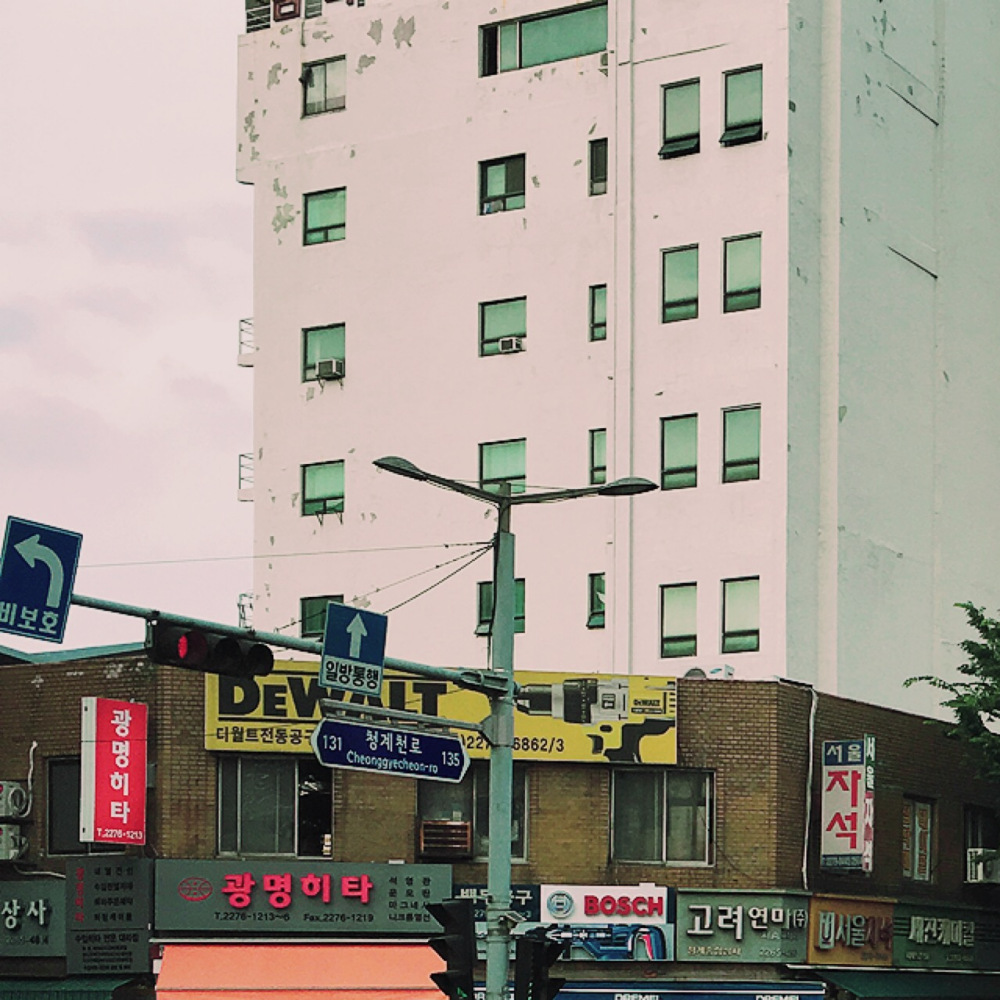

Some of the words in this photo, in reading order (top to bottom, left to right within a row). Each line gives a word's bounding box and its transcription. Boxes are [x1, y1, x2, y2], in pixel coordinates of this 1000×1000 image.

[0, 601, 59, 634] 비보호
[326, 661, 379, 690] 일방통행
[322, 735, 342, 750] 131
[366, 730, 422, 755] 청계천로
[827, 743, 862, 763] 서울
[110, 709, 132, 824] 광명히타
[346, 751, 438, 774] Cheonggyecheon-ro
[441, 751, 460, 766] 135
[826, 770, 862, 849] 자석
[222, 872, 374, 909] 광명히타
[1, 899, 47, 929] 상사
[584, 895, 664, 917] BOSCH
